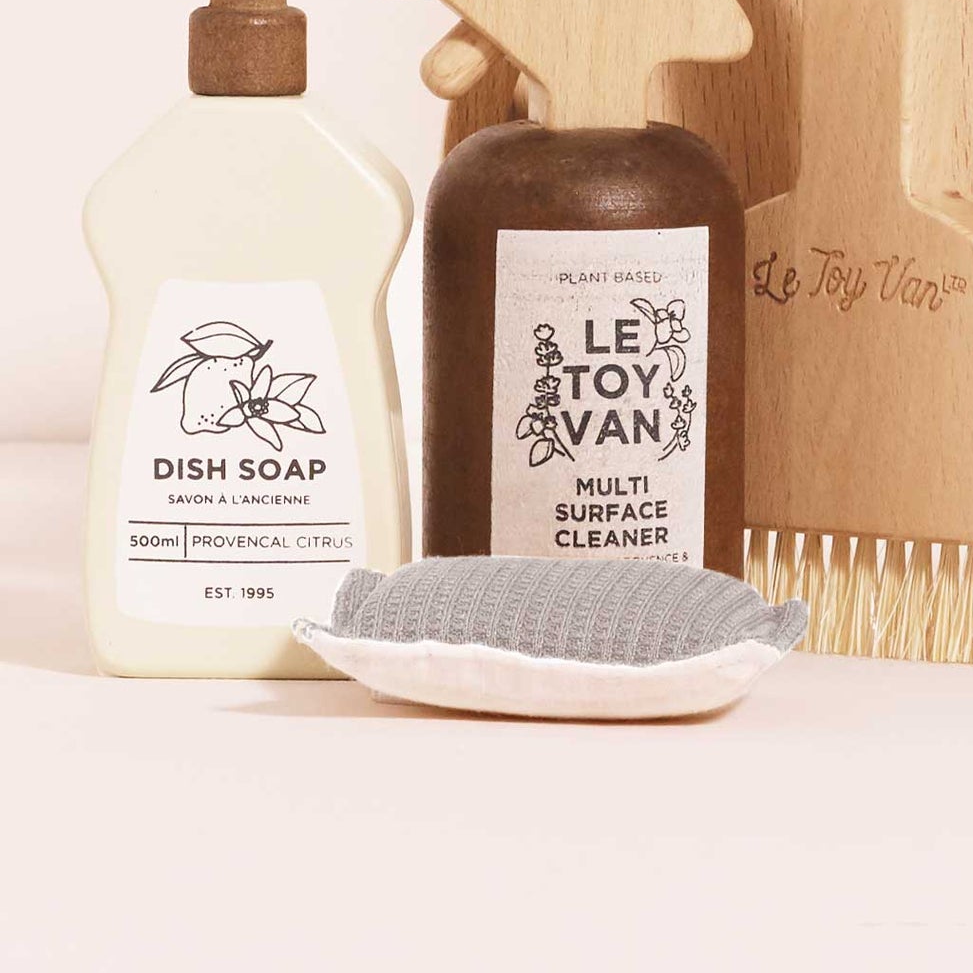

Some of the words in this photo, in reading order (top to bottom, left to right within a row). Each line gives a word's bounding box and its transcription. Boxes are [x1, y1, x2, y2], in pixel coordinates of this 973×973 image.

[559, 272, 607, 285] PLANT
[614, 271, 662, 284] BASED
[753, 251, 800, 305] Le
[808, 247, 867, 312] Toy
[874, 255, 943, 312] Van
[585, 318, 641, 355] LE
[562, 363, 660, 400] TOY
[560, 408, 661, 446] VAN
[153, 458, 226, 481] DISH
[238, 458, 327, 481] SOAP
[576, 475, 649, 497] MULTI
[168, 494, 214, 505] SAVON
[217, 491, 228, 505] À
[232, 494, 311, 506] L'ANCIENNE
[555, 499, 668, 523] SURFACE
[129, 535, 179, 548] 500ml
[192, 535, 290, 549] PROVENCAL
[296, 535, 353, 549] CITRUS
[554, 526, 669, 550] CLEANER
[204, 586, 237, 600] EST.
[241, 586, 275, 600] 1995
